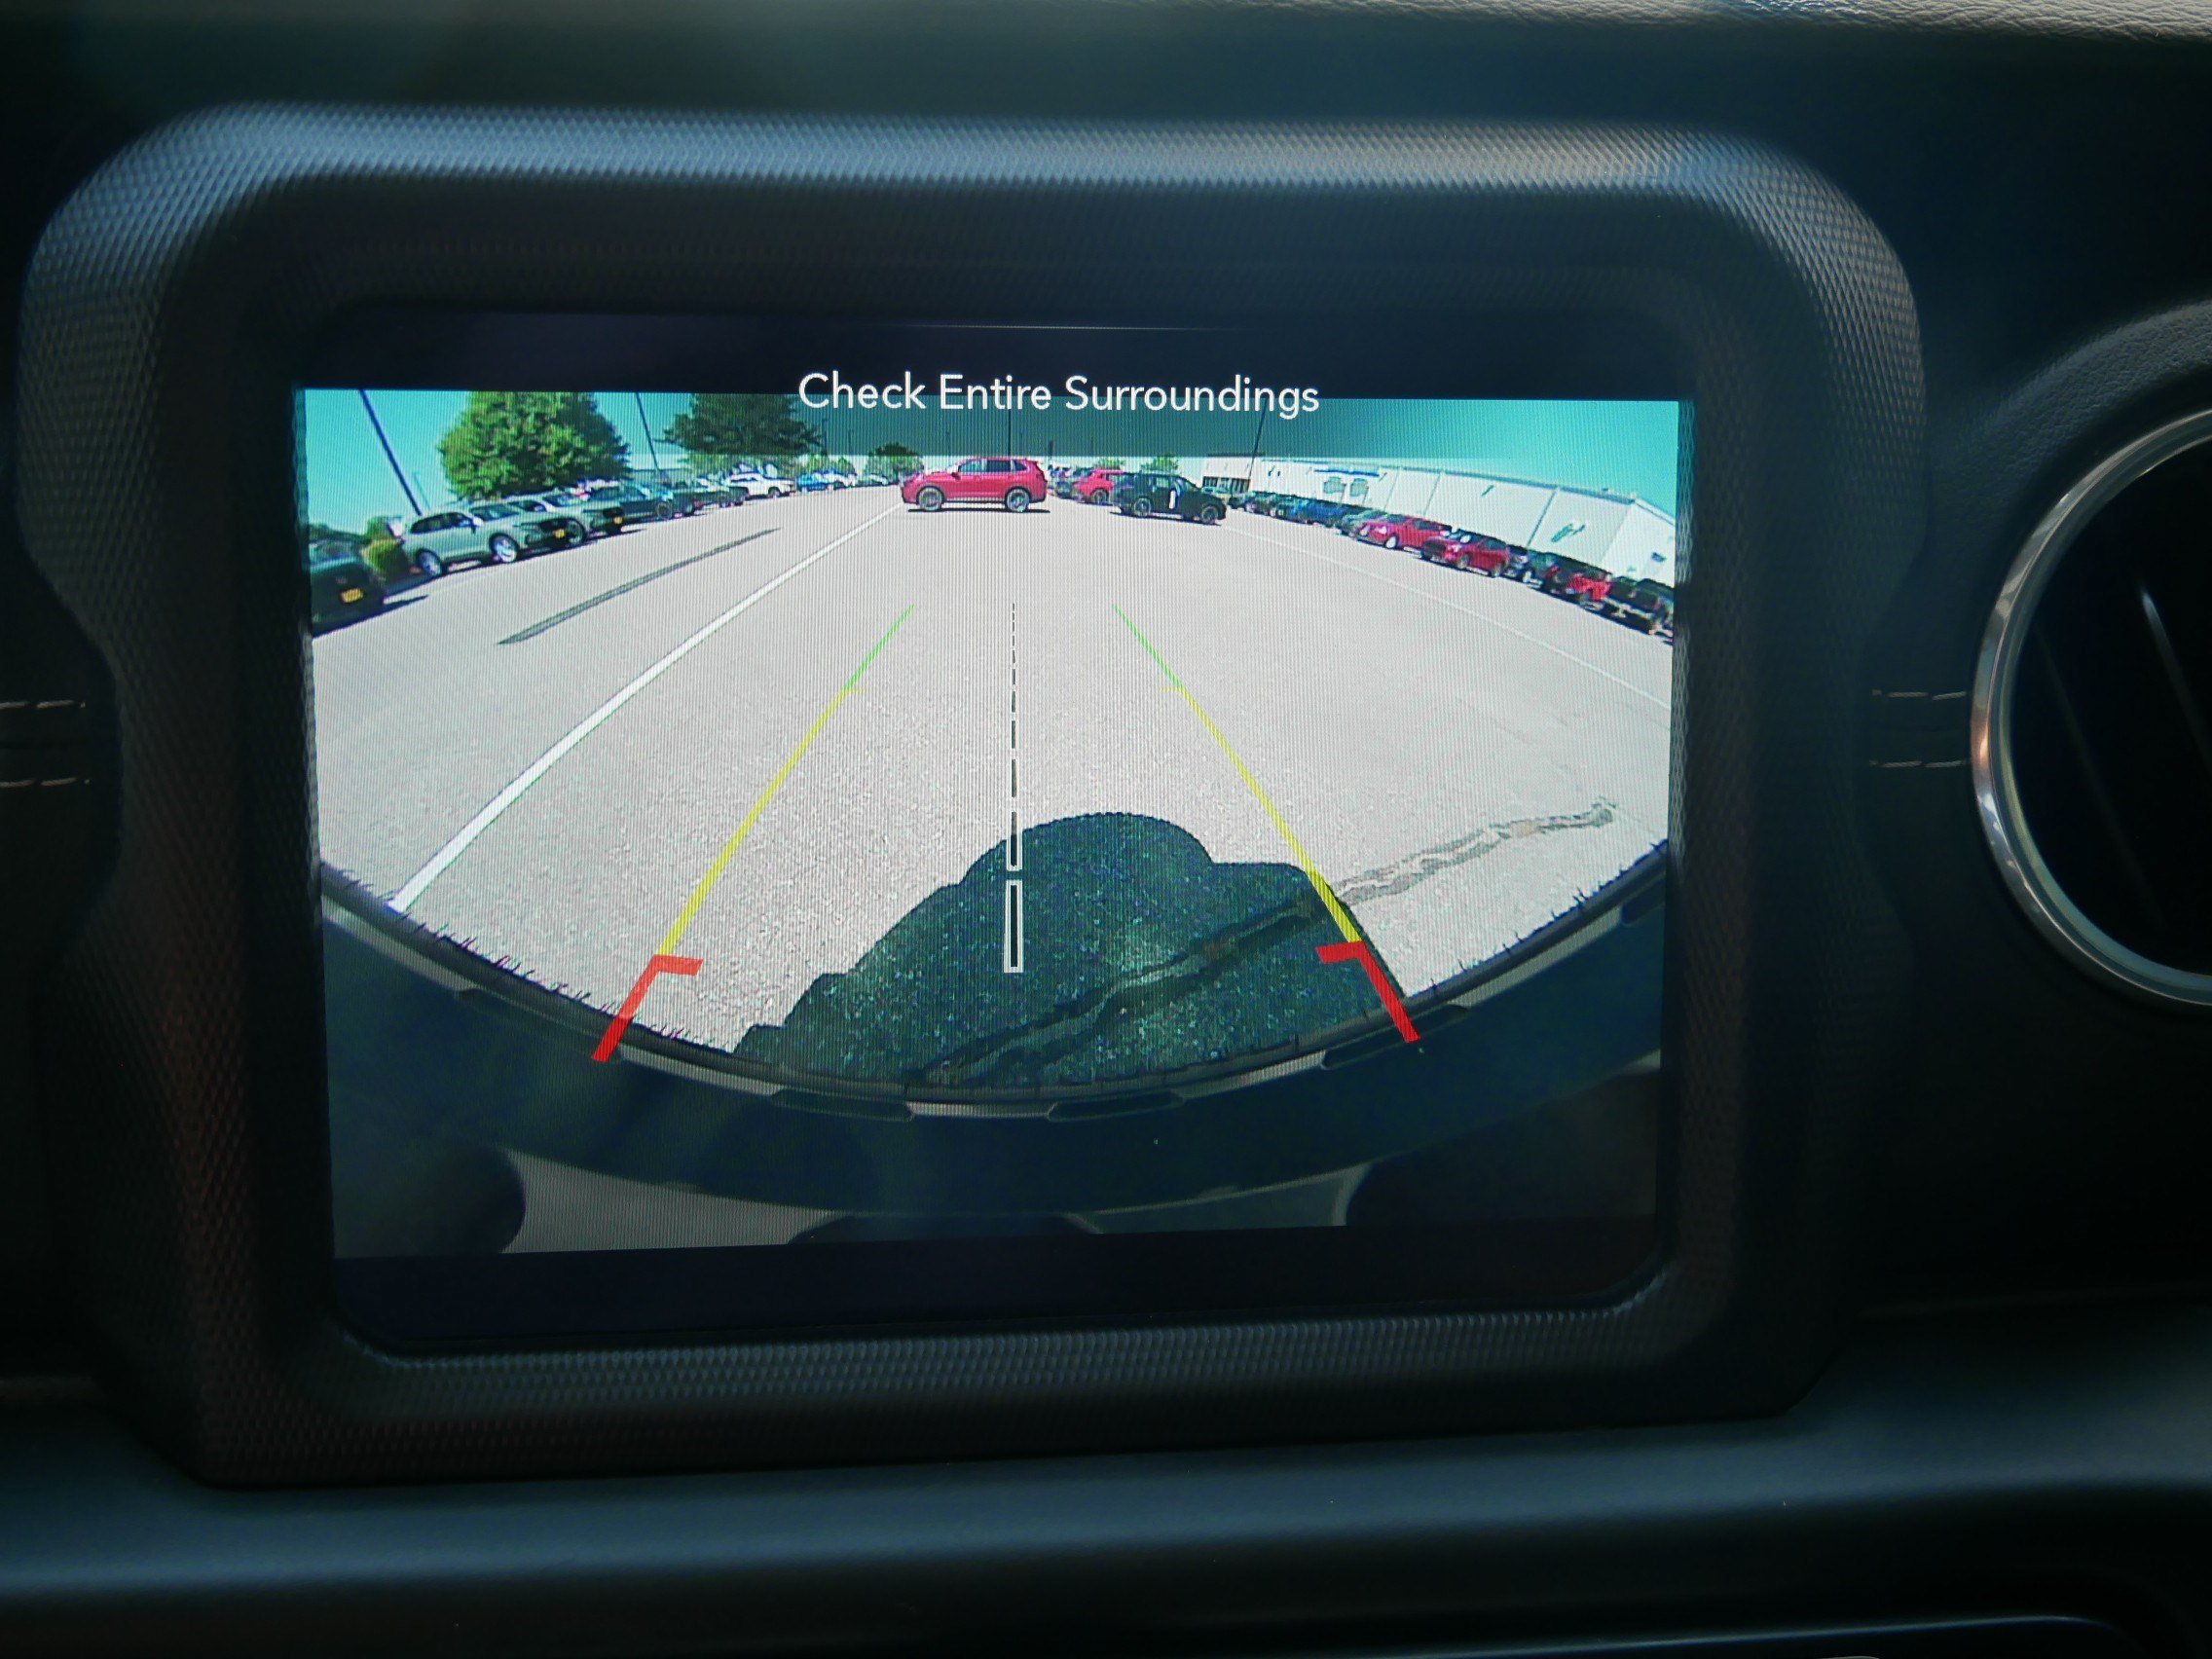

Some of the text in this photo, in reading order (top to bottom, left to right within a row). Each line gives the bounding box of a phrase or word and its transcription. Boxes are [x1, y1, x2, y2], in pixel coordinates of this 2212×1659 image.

[797, 370, 1321, 421] Check Entire Surroundings
